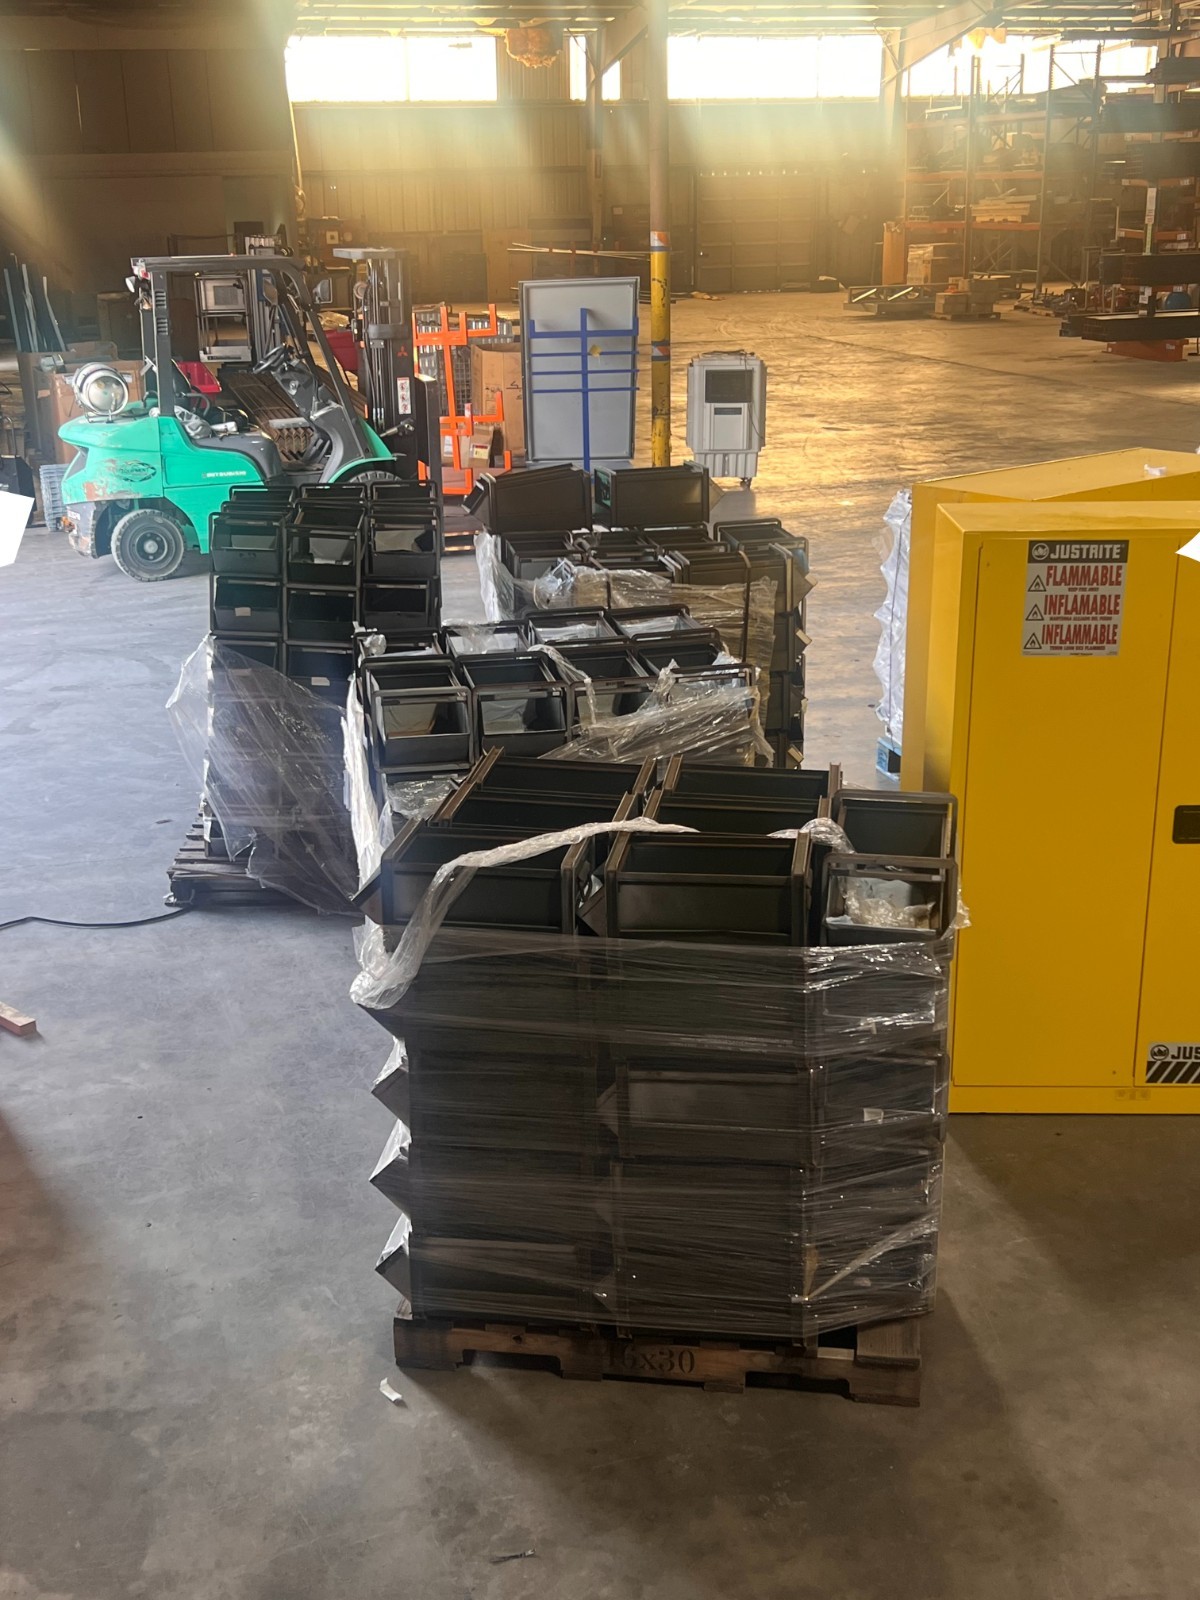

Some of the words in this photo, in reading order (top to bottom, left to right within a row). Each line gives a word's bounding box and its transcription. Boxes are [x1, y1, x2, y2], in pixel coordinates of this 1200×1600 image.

[1050, 544, 1121, 559] JUSTRITE
[1046, 565, 1122, 586] FLAMMABLE
[1044, 594, 1121, 615] INFLAMABLE
[1041, 624, 1118, 645] INFLAMMABLE
